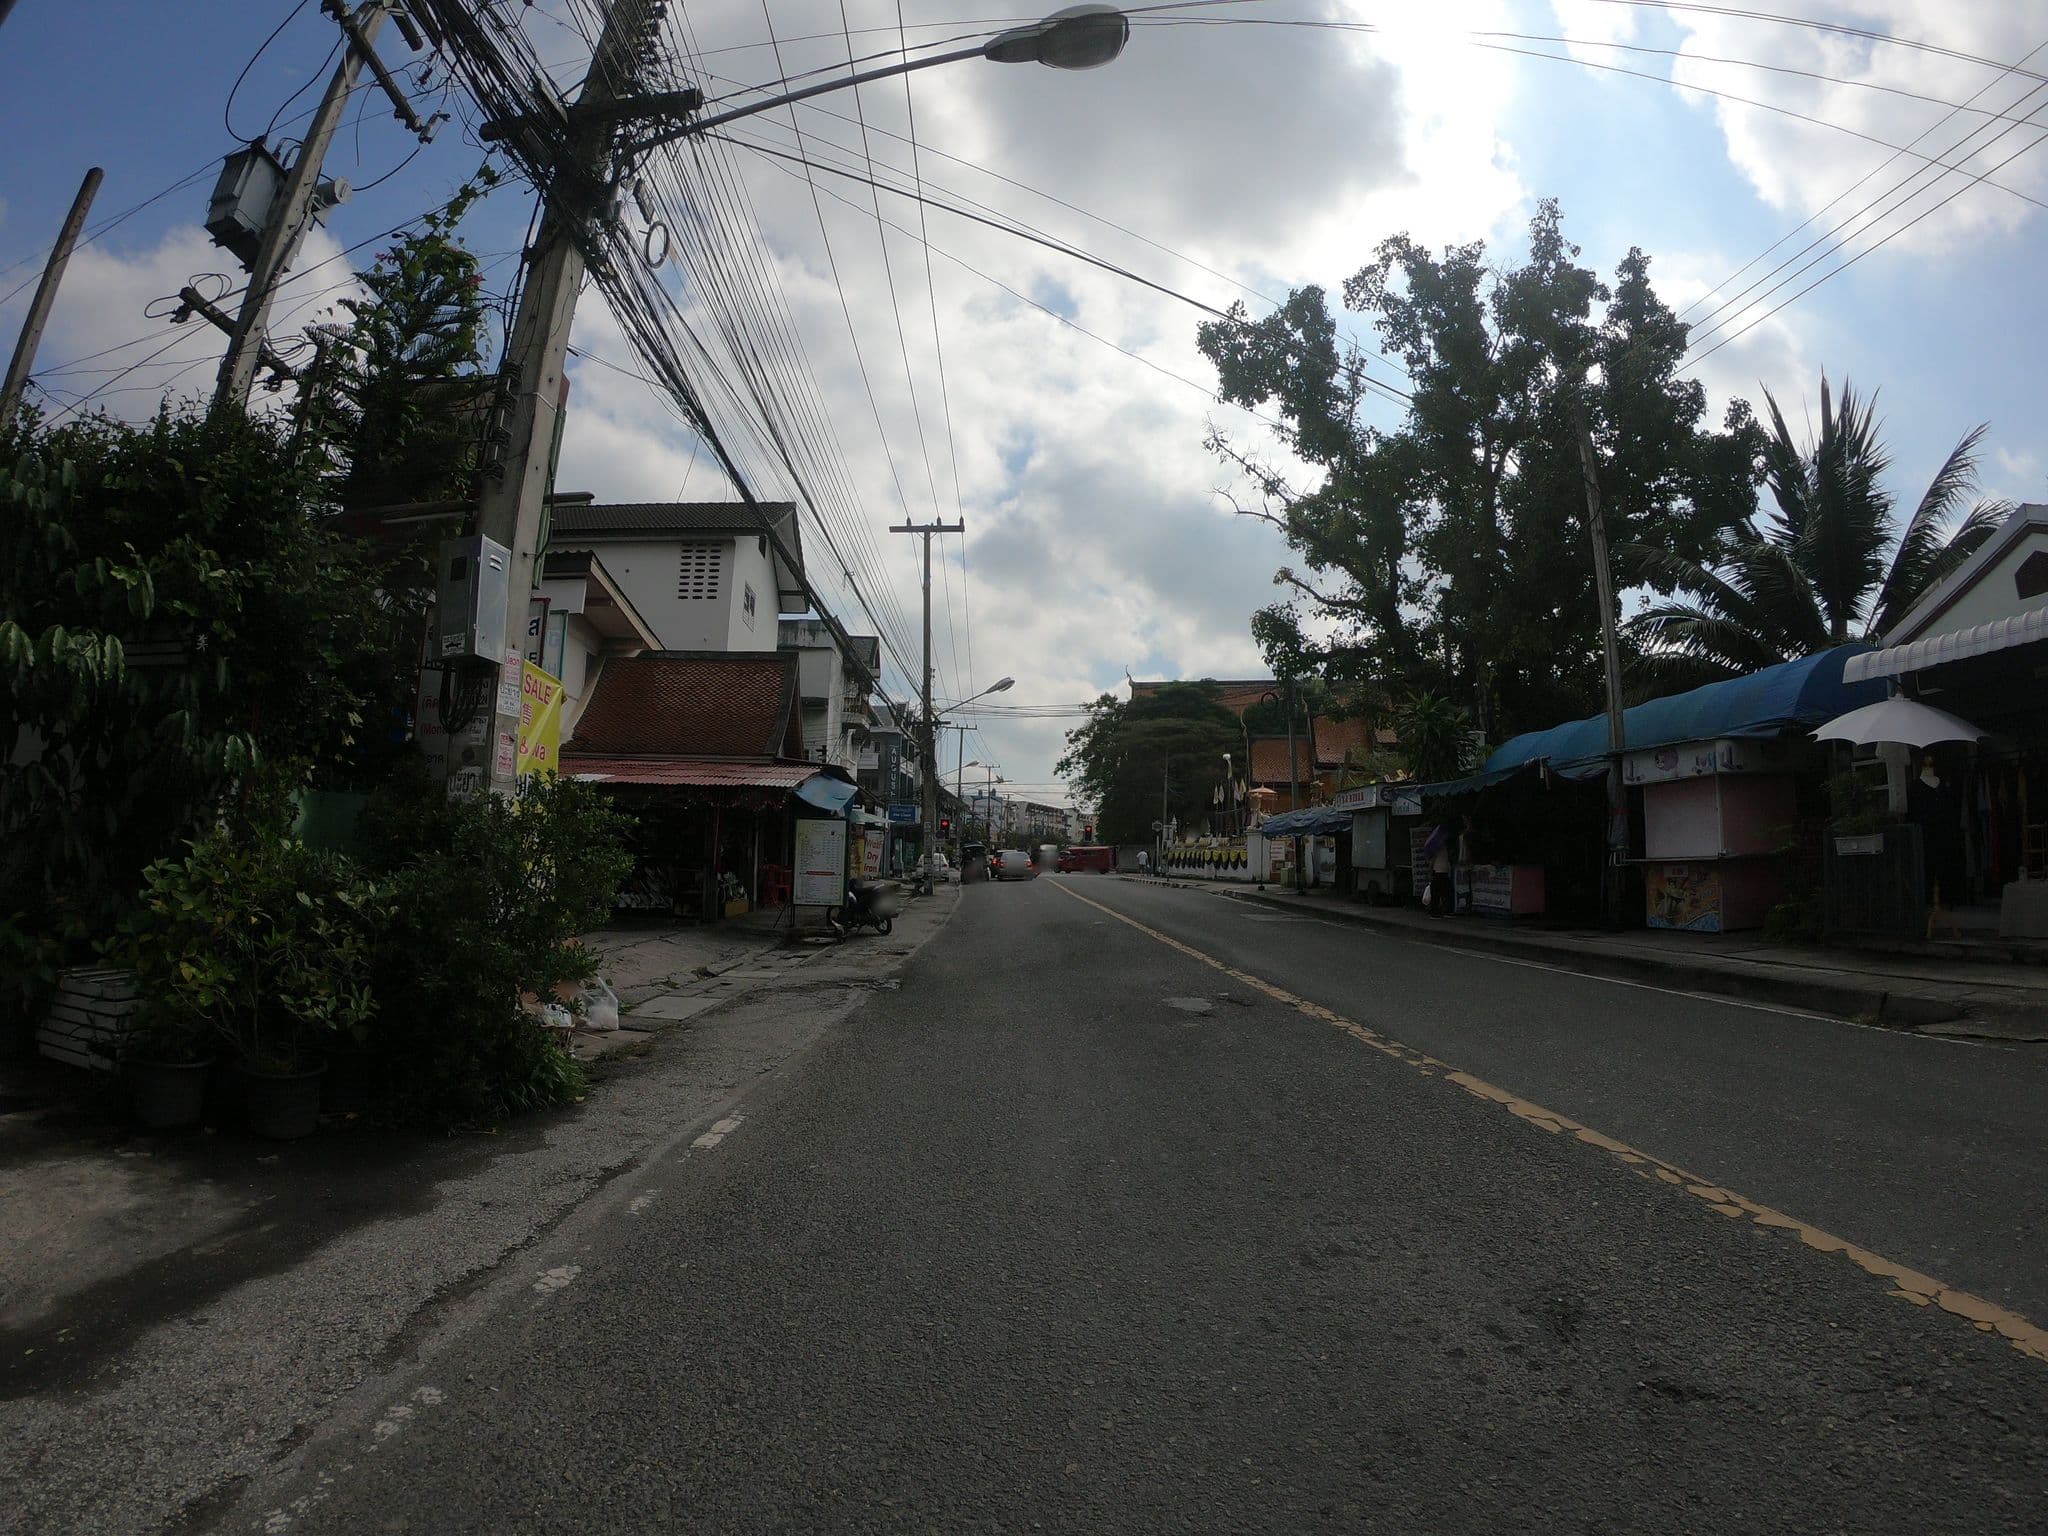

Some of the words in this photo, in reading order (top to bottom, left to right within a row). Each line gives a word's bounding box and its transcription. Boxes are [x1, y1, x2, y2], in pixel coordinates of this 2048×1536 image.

[524, 673, 552, 705] SALE
[867, 851, 879, 863] Dry
[863, 864, 878, 873] Iron
